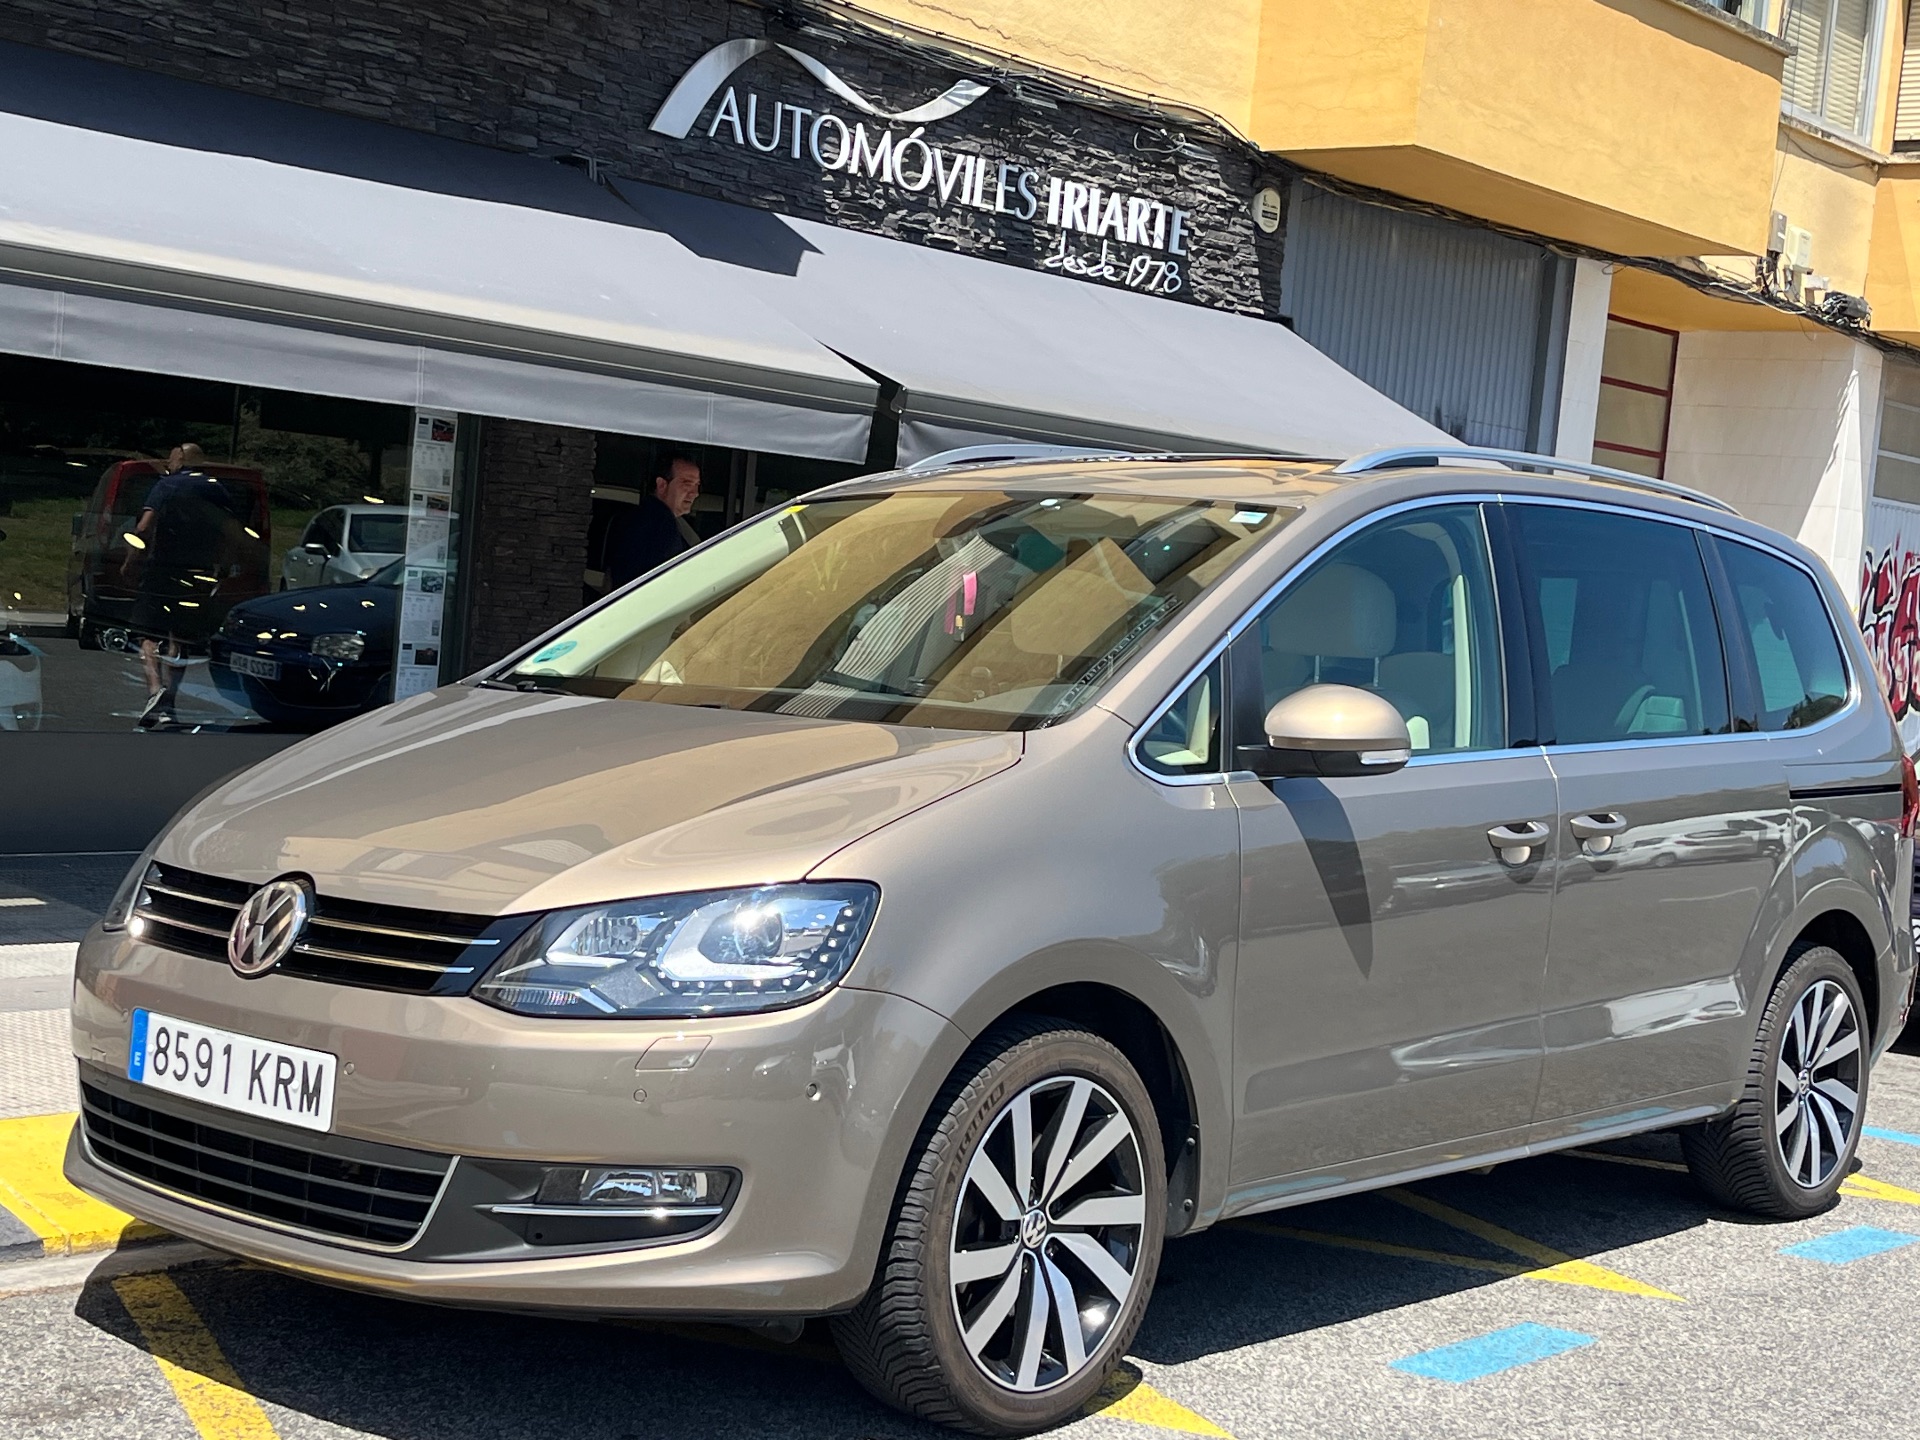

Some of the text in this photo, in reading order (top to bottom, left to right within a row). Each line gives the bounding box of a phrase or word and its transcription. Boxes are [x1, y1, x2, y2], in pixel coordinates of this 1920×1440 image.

[707, 86, 1191, 256] AUTOMÓVILES IRIARTE
[1043, 230, 1182, 293] desde 1978
[153, 1027, 323, 1117] 8591 KRM
